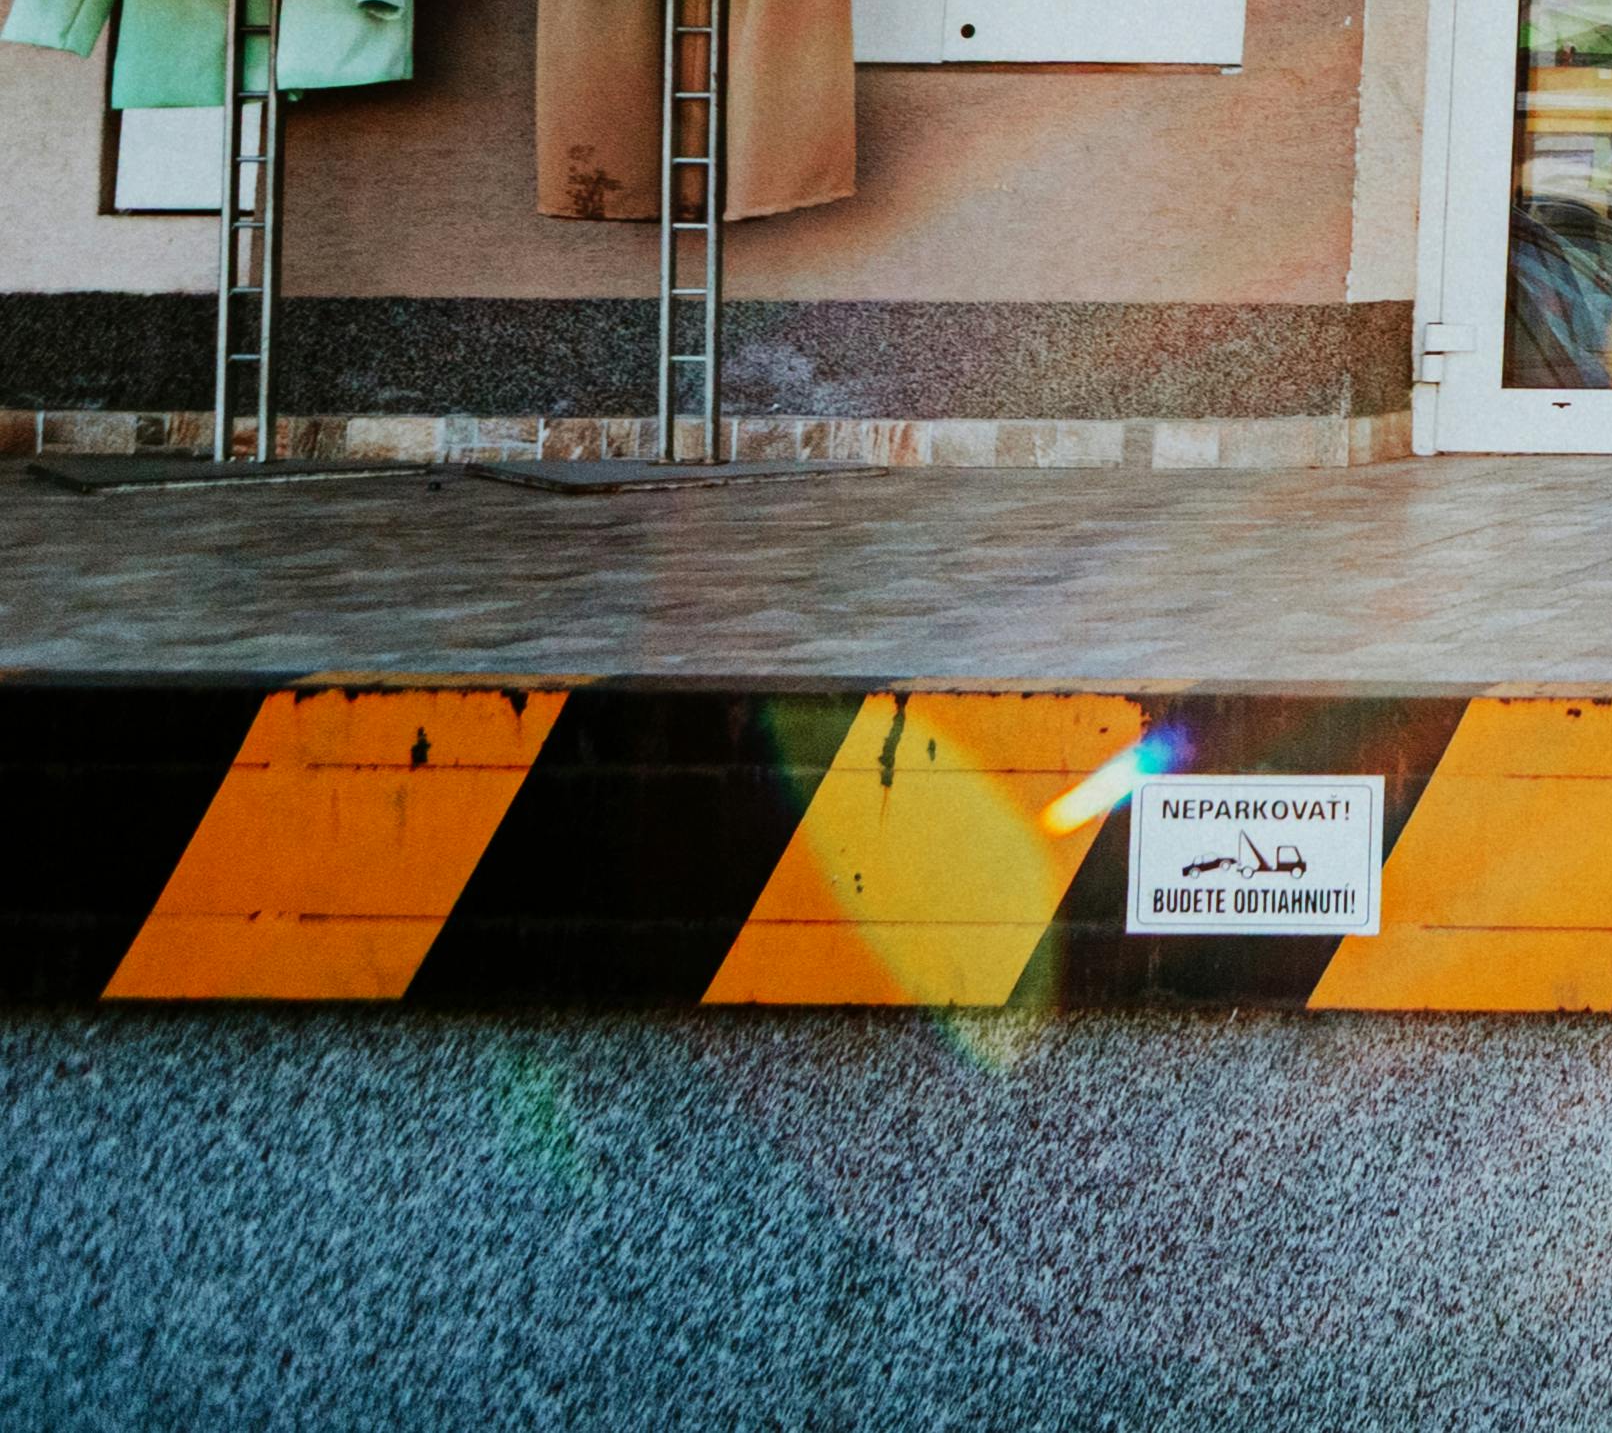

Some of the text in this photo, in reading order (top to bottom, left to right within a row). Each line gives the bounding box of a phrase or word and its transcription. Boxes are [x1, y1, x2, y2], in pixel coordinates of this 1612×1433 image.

[1163, 794, 1349, 820] NEPARKOVAŤ!
[1153, 883, 1355, 914] BUDETE ODTIAHNUTÍ!
